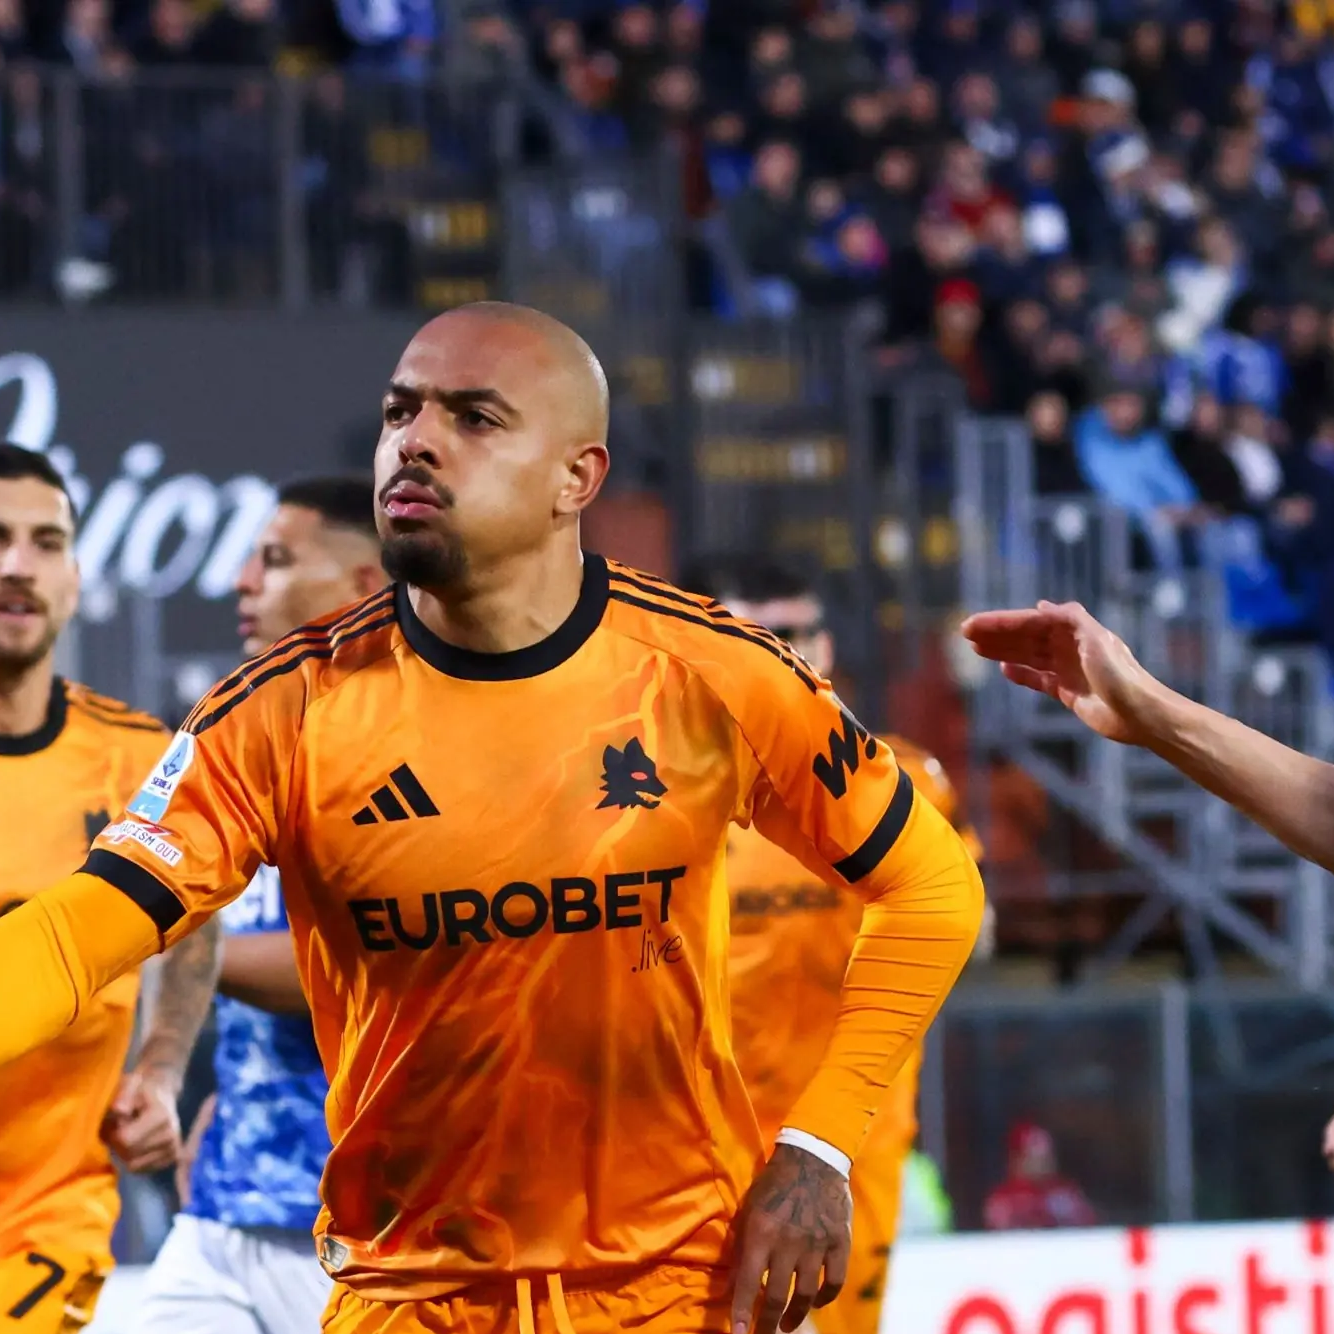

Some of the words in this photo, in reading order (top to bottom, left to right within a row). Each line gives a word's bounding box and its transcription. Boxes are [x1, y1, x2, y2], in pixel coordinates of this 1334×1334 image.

[155, 842, 180, 862] OUT
[347, 865, 687, 952] EUROBET
[631, 928, 683, 973] .live
[8, 1251, 66, 1319] 7
